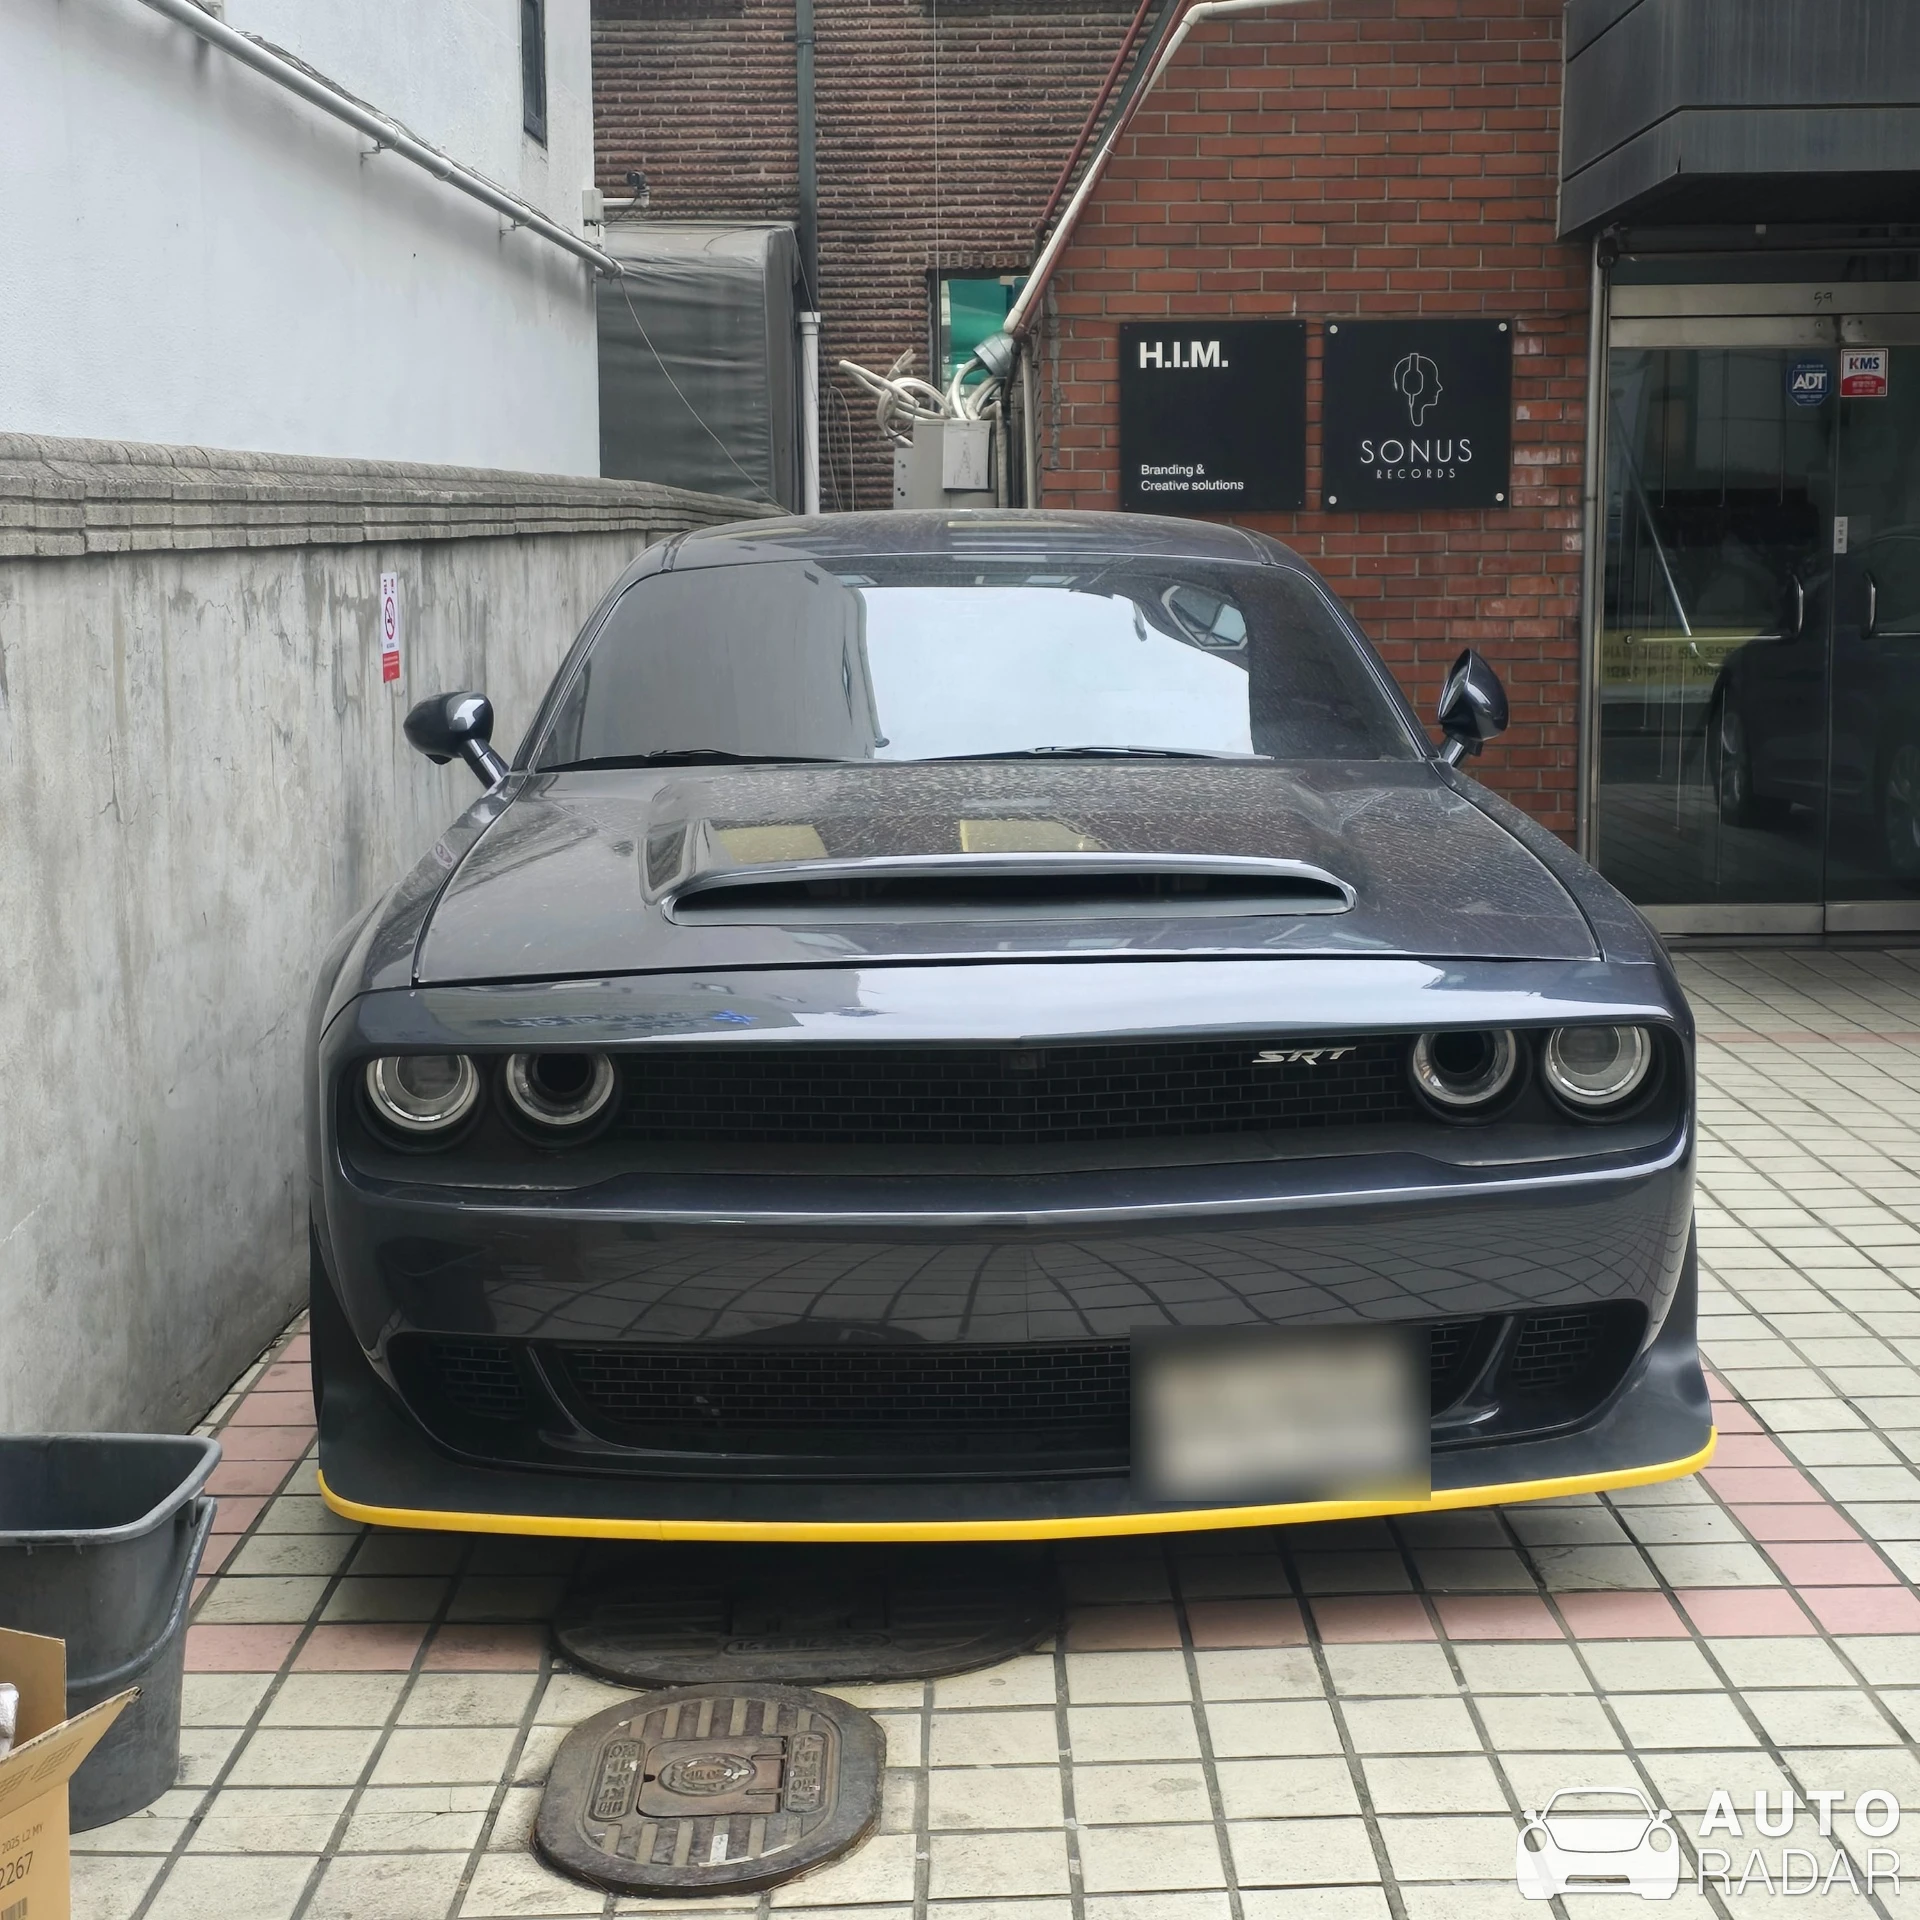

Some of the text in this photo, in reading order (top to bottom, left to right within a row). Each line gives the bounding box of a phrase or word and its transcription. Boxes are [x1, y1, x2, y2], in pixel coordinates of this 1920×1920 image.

[1138, 340, 1229, 369] H.I.M.
[1849, 357, 1880, 370] KMS
[1792, 373, 1827, 390] ADT
[1360, 438, 1473, 464] SONUS
[1140, 464, 1205, 478] Branding &
[1376, 467, 1457, 480] RECORDS
[1140, 480, 1244, 491] Creative solutions
[1251, 1046, 1357, 1065] SRT
